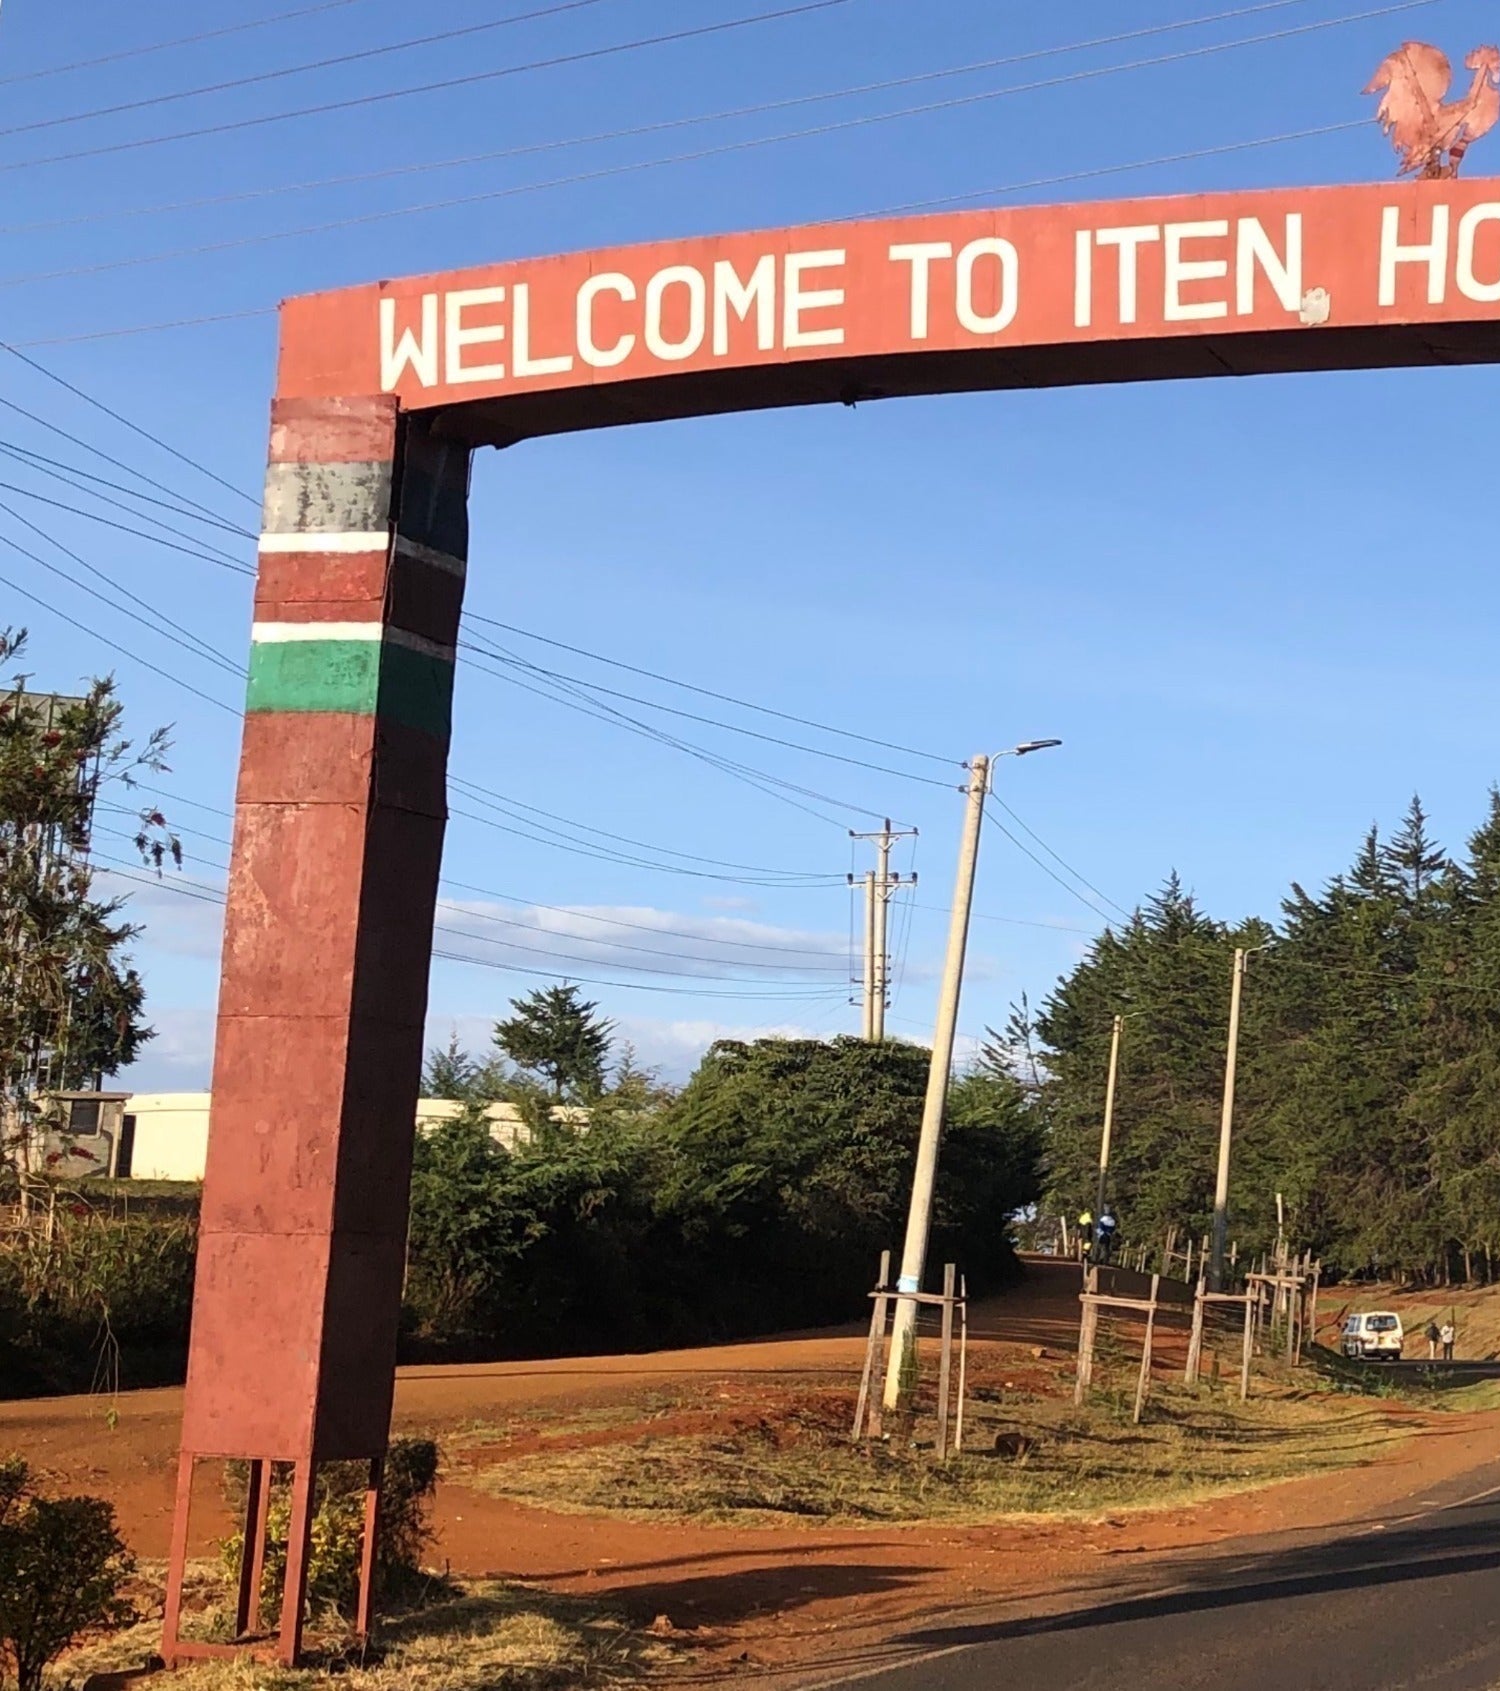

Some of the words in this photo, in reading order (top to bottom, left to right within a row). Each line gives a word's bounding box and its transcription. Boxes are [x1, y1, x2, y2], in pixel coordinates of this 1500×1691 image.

[380, 248, 846, 392] WELCOME
[889, 238, 1019, 339] TO
[1074, 213, 1302, 327] ITEN
